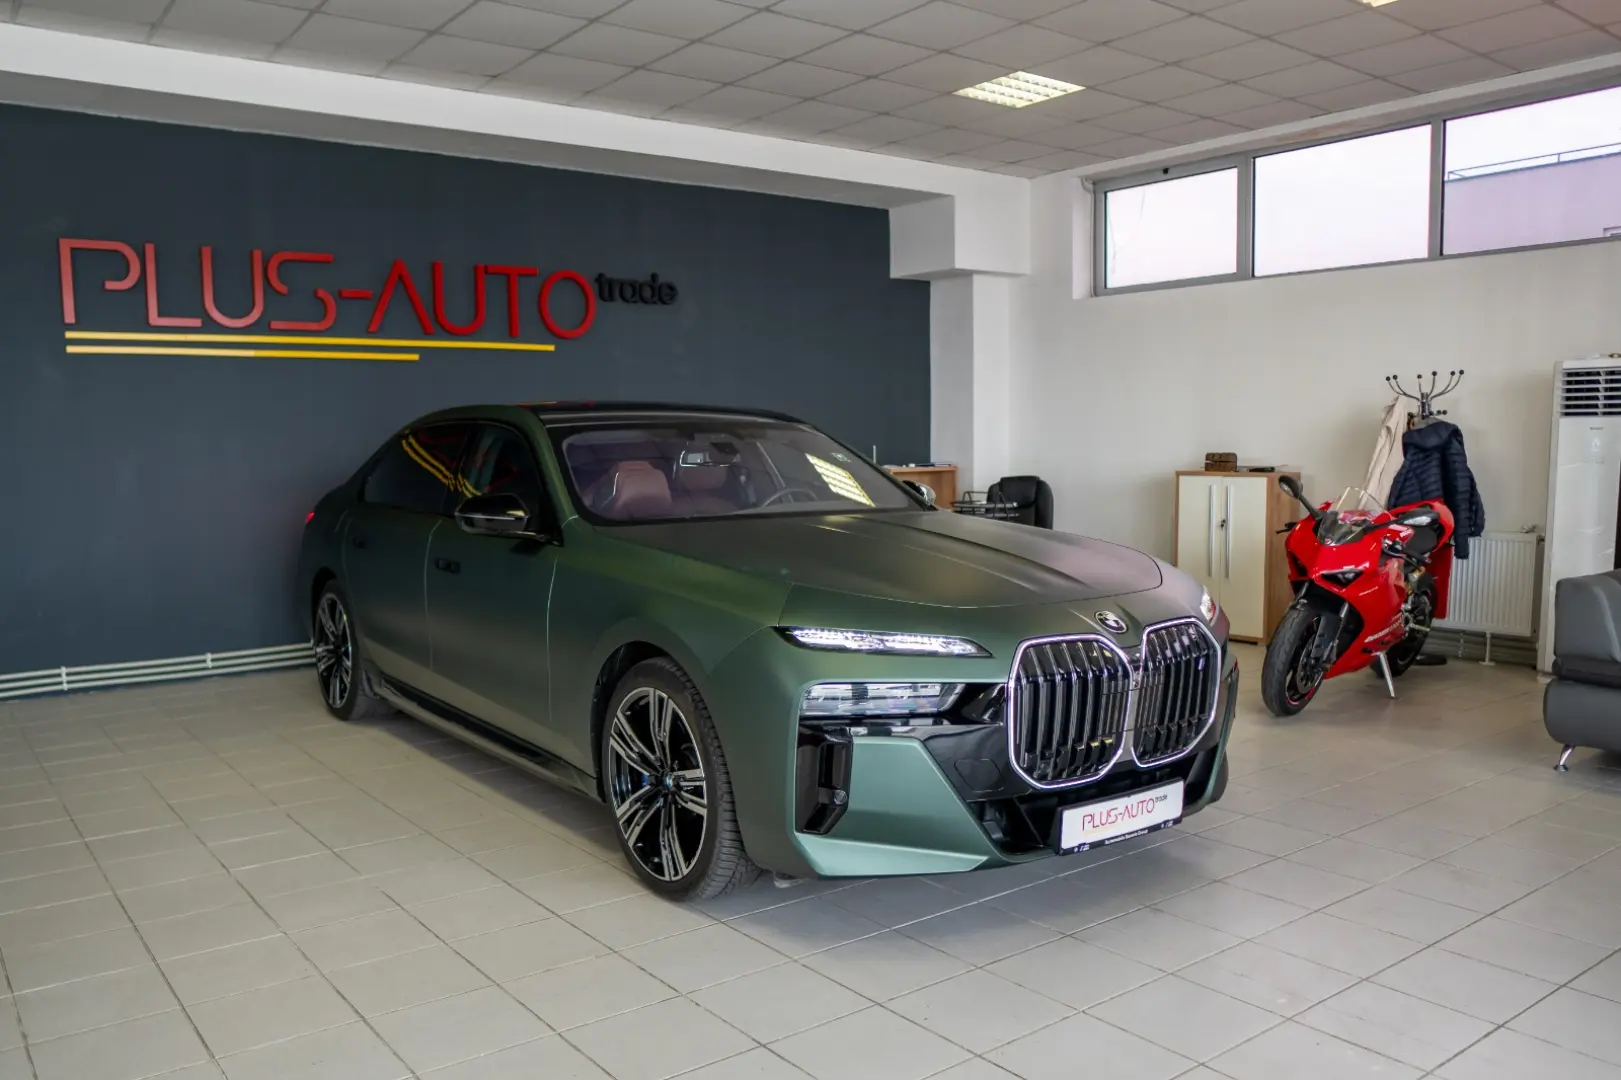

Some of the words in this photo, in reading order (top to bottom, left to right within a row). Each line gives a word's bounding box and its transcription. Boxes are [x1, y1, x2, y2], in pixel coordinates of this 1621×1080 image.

[58, 237, 597, 341] PLUS-AUTO
[595, 272, 678, 305] trade
[1082, 797, 1155, 831] PLUS-AUTO
